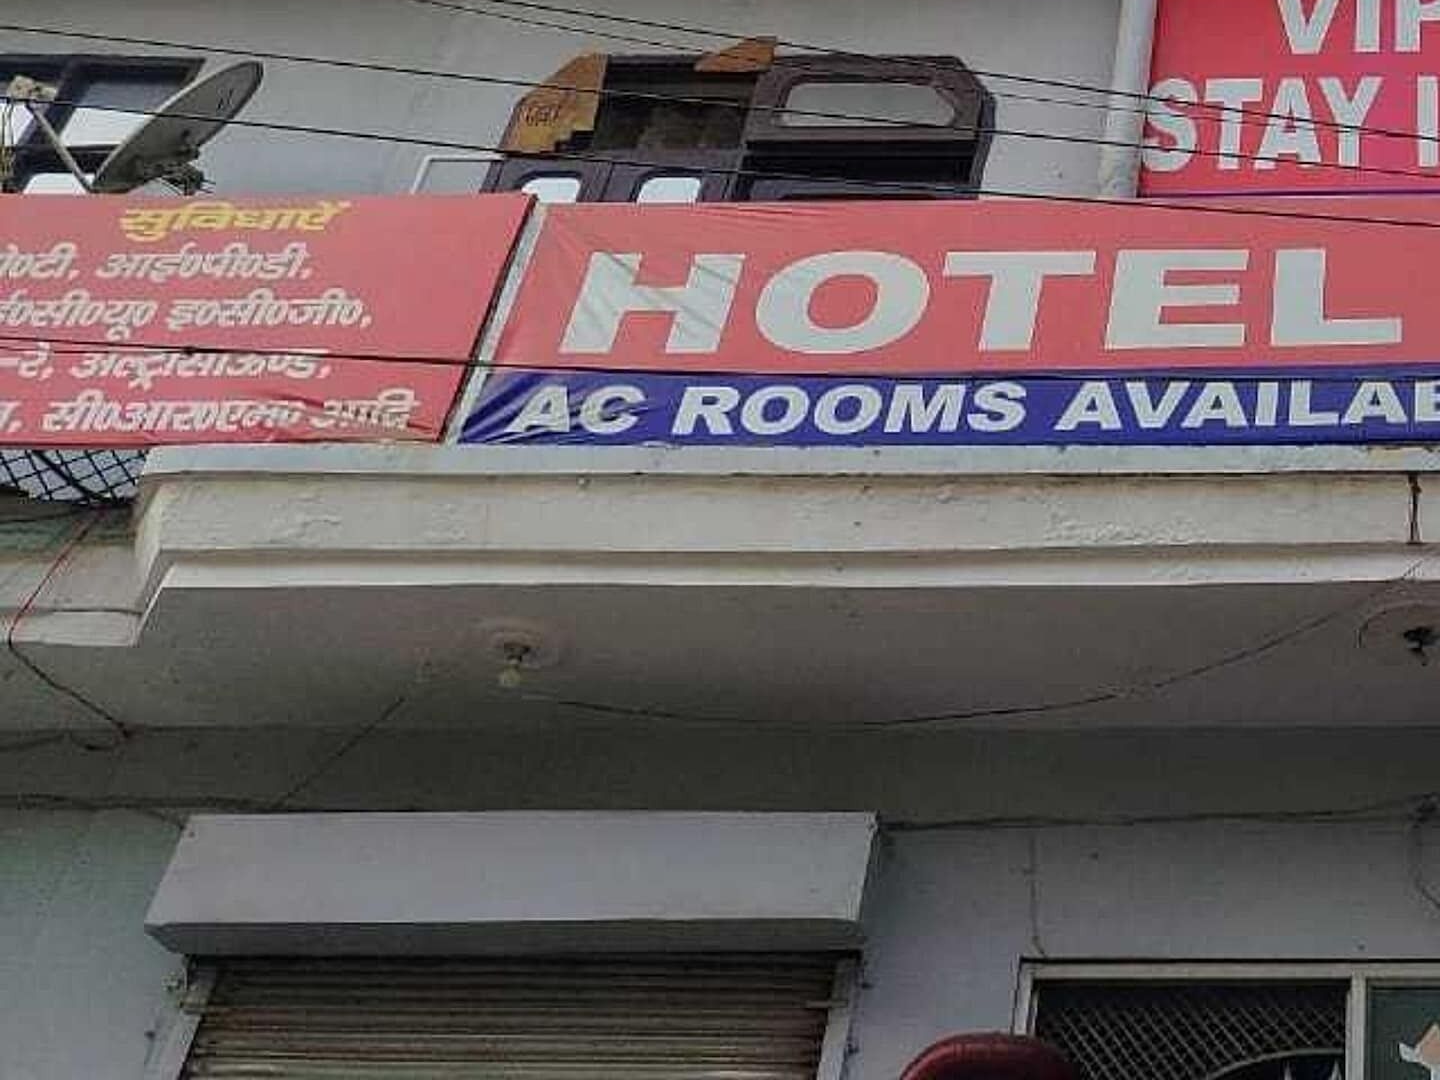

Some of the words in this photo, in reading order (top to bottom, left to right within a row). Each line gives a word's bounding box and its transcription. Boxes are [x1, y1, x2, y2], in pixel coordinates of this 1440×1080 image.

[1141, 73, 1382, 172] STAY
[559, 249, 1403, 355] HOTEL
[505, 383, 646, 434] AC
[670, 380, 1029, 435] ROOMS
